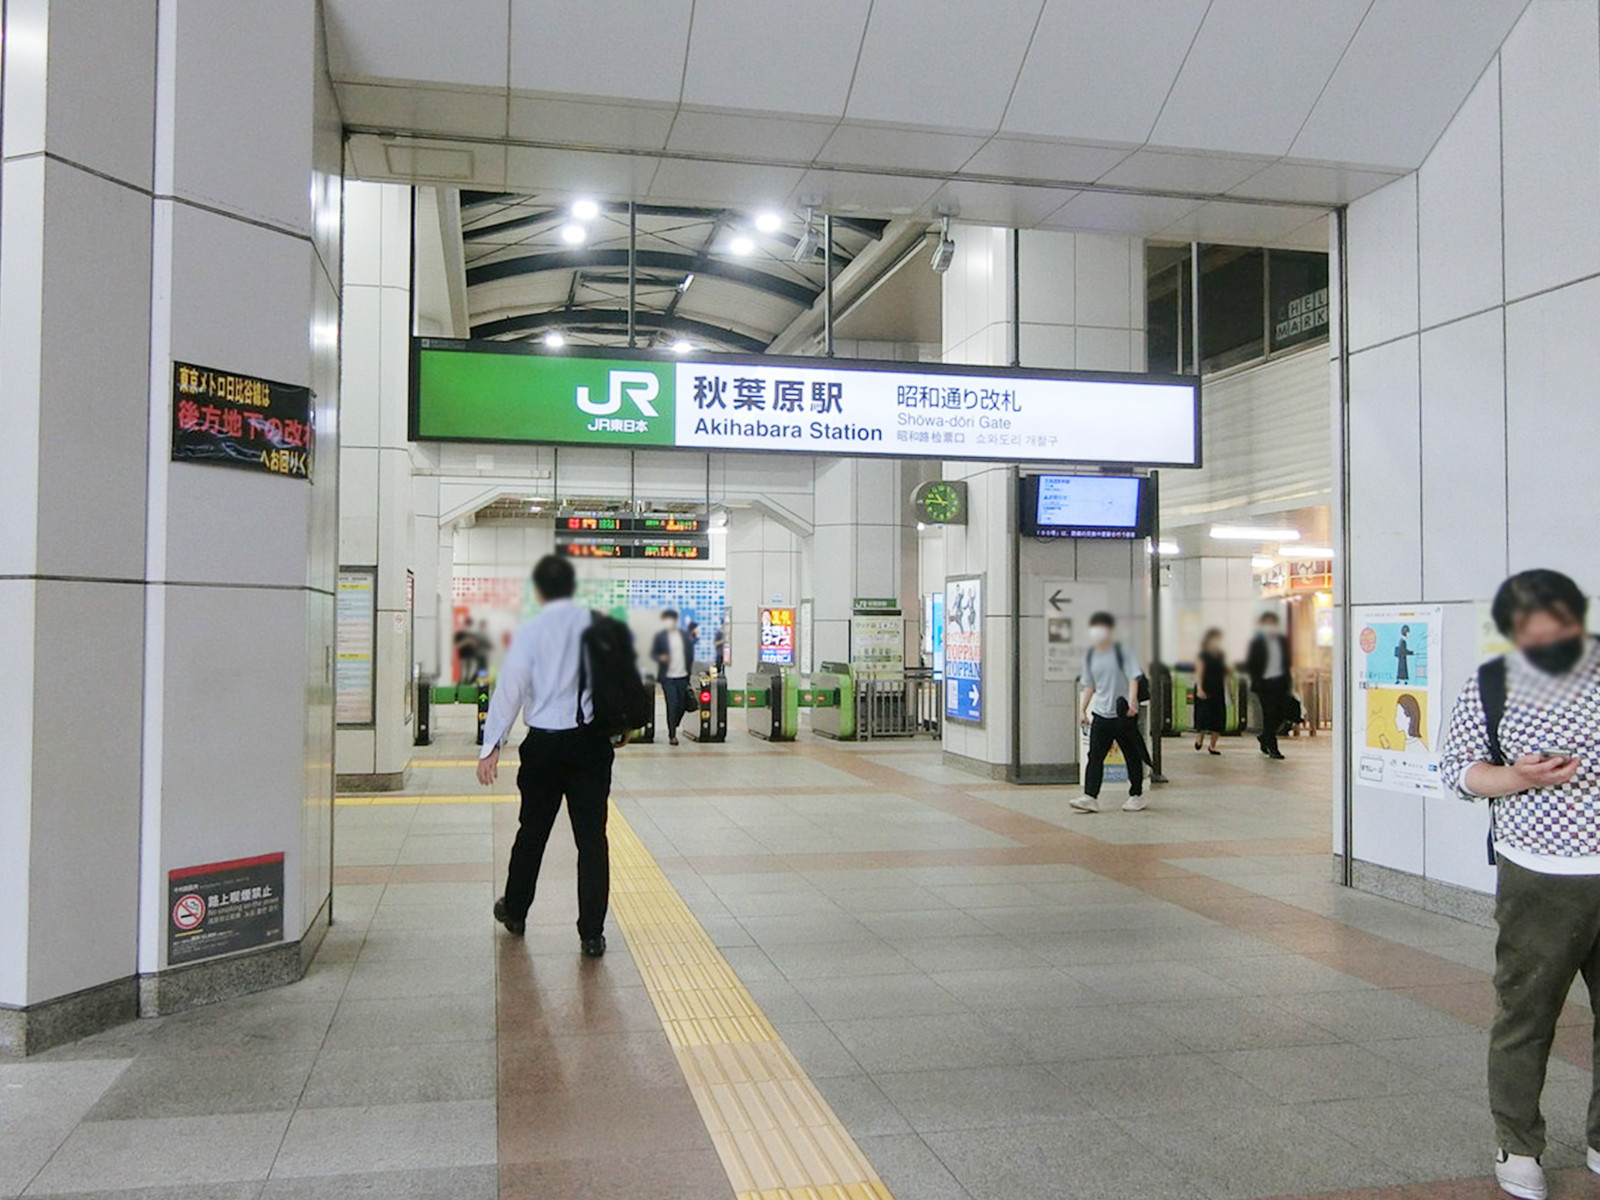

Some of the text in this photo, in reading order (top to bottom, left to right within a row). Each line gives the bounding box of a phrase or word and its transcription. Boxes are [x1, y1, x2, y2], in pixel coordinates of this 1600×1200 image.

[576, 370, 660, 417] JR
[693, 375, 844, 415] 秋葉原駅
[897, 384, 1023, 413] 昭和通り改札
[586, 417, 649, 433] JR東日本
[694, 417, 883, 442] Akihabara Station
[979, 414, 1012, 430] Gate
